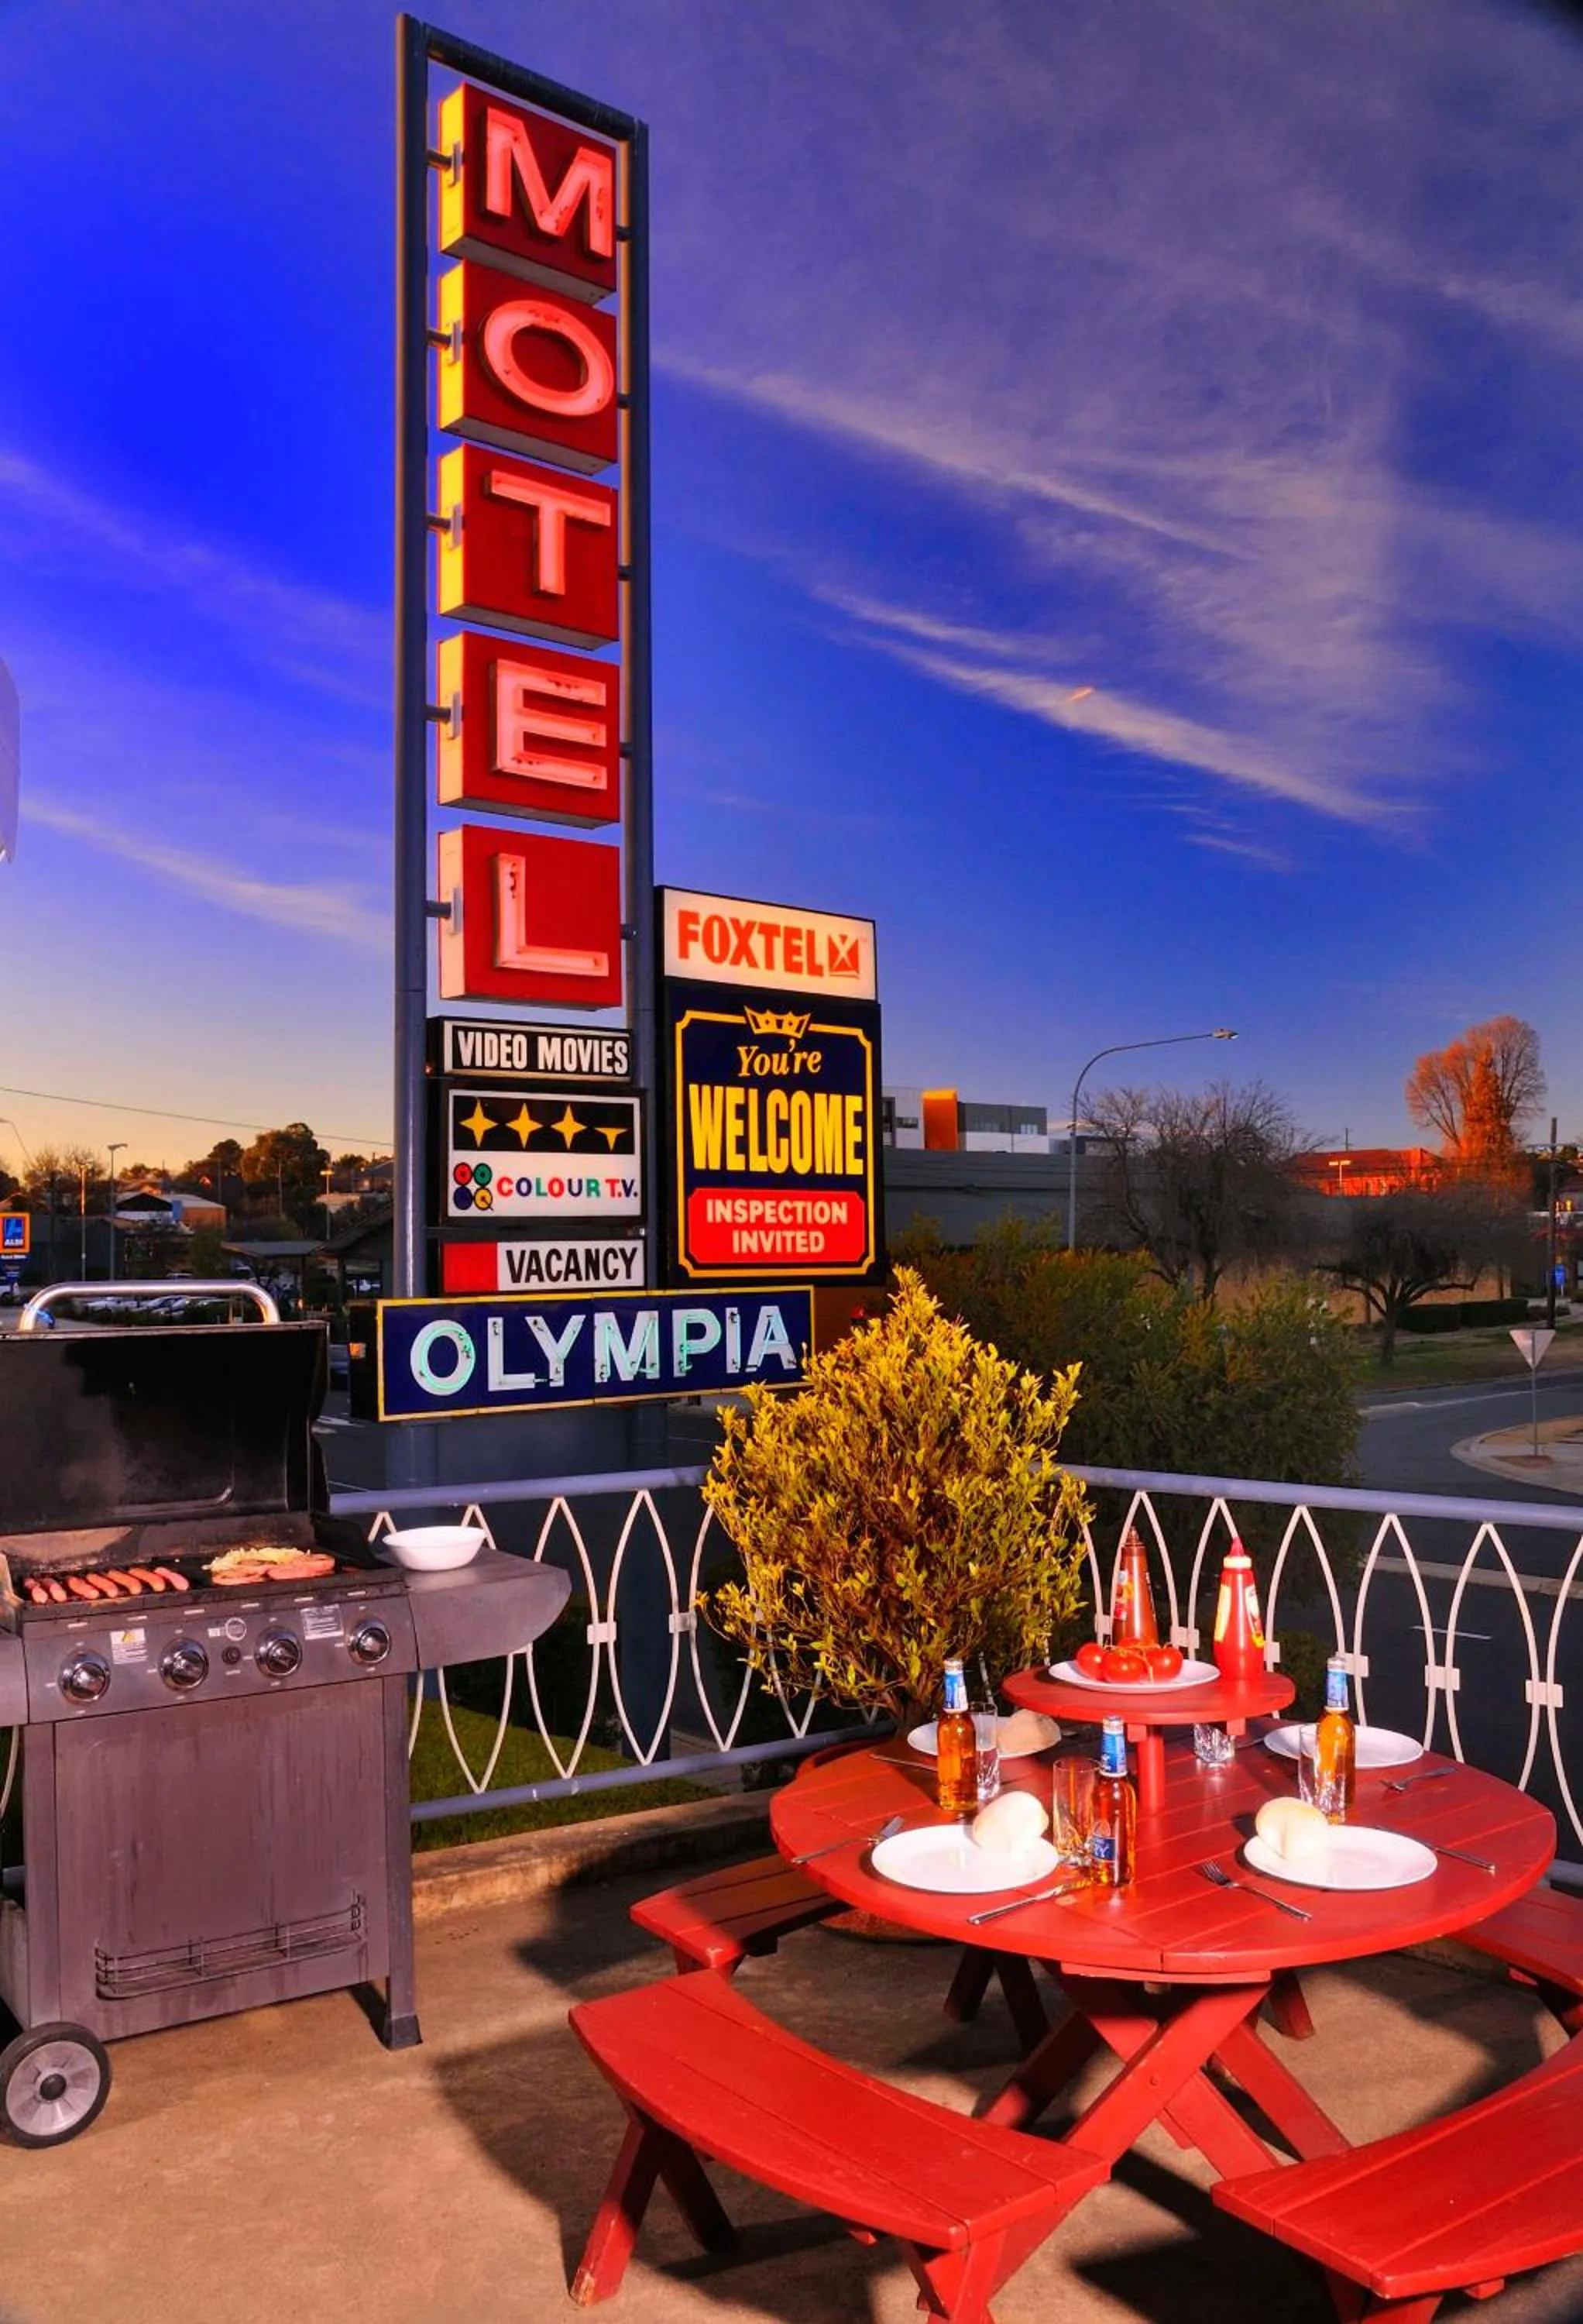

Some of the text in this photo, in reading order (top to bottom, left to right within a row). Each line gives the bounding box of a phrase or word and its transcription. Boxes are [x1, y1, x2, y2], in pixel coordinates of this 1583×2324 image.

[486, 105, 615, 978] MOTEL
[678, 909, 824, 978] FOXTEL
[458, 1031, 629, 1074] VIDEO MOVIES
[737, 1038, 822, 1077] You're
[688, 1084, 864, 1175] WELCOME
[496, 1177, 639, 1198] COLOUR T.V.
[706, 1198, 848, 1225] INSPECTION
[733, 1229, 826, 1253] INVITED
[506, 1246, 638, 1284] VACANCY
[410, 1305, 798, 1396] OLYMPIA
